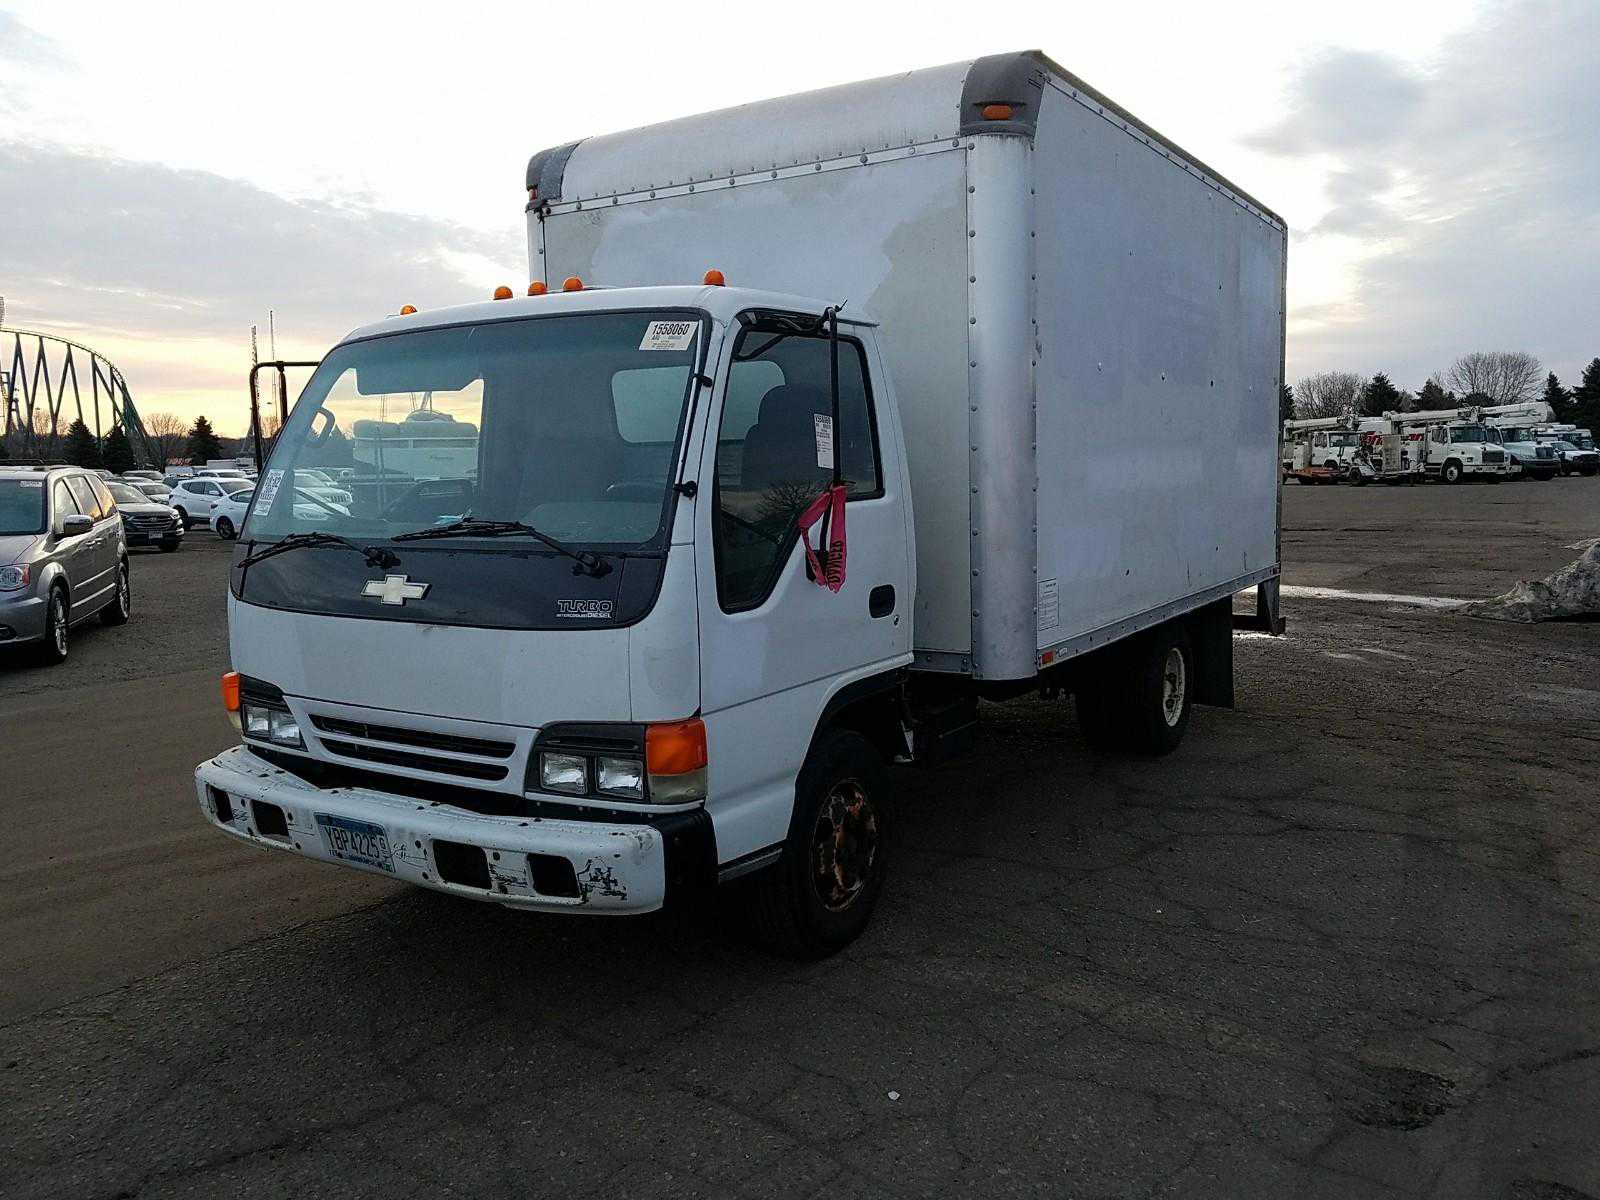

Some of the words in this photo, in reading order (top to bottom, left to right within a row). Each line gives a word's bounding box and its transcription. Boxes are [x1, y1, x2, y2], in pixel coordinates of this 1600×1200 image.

[652, 323, 690, 336] 1558060
[557, 599, 613, 613] TURBO
[324, 825, 380, 859] YBP4225
